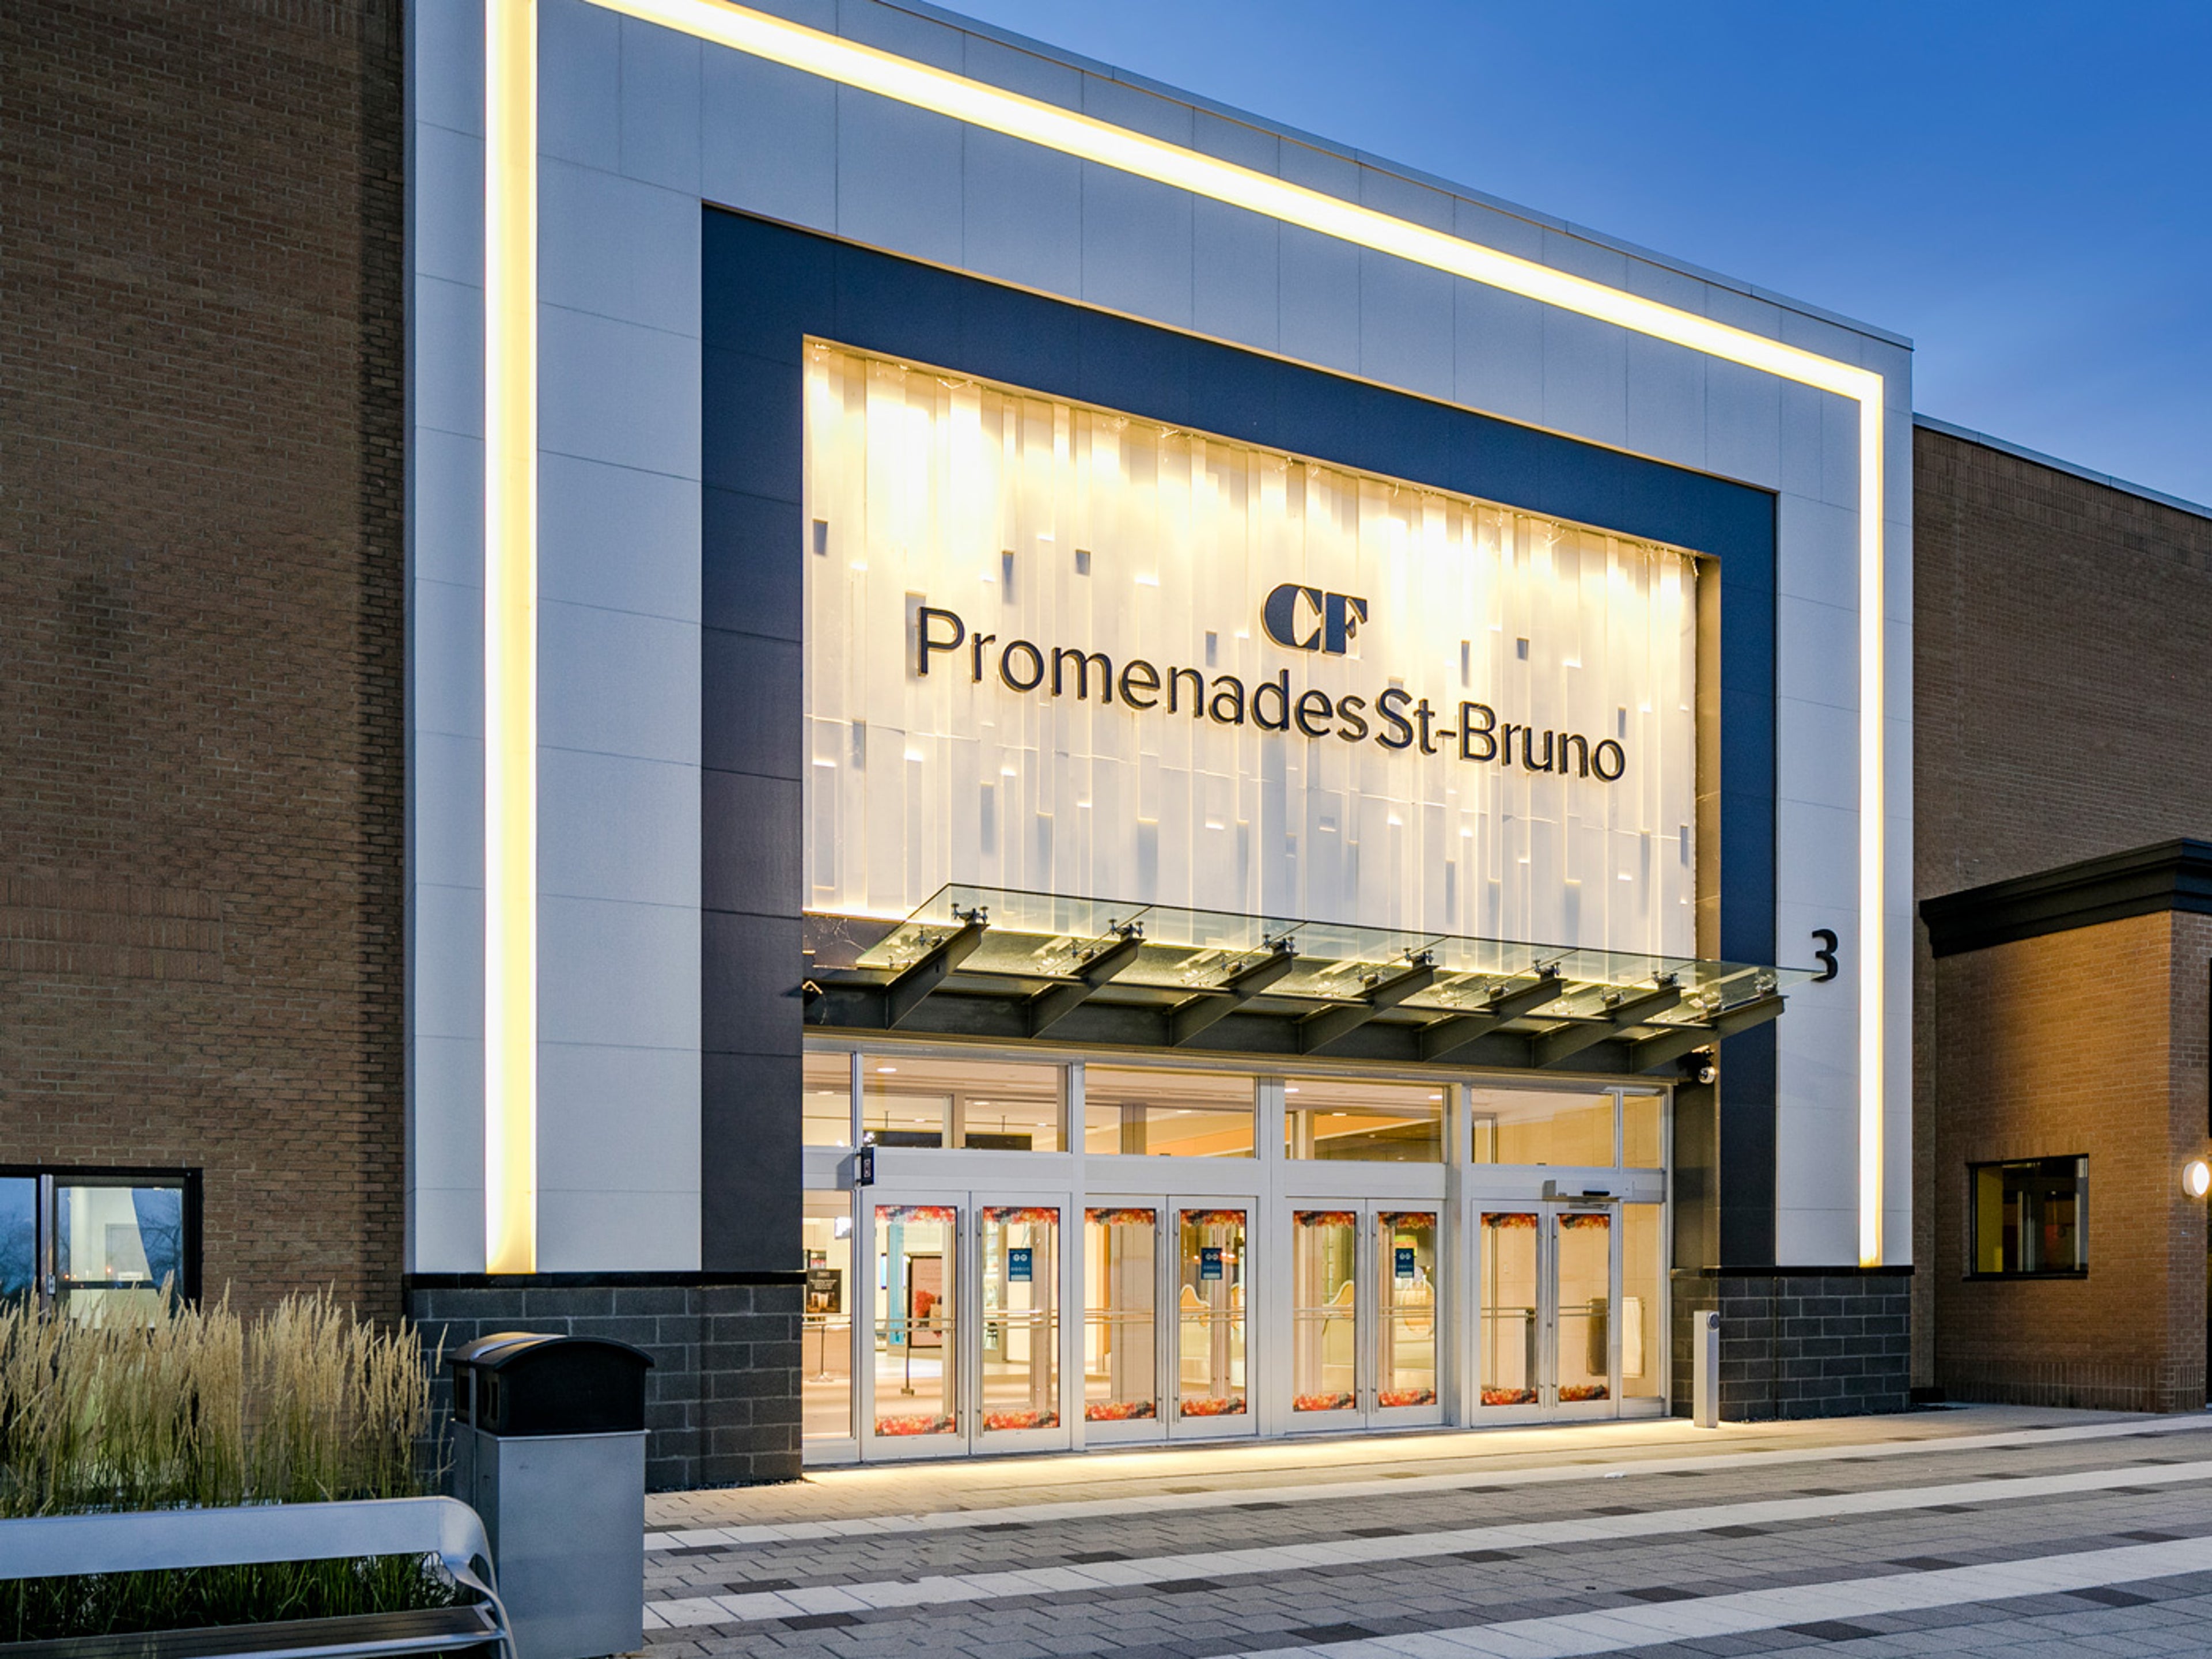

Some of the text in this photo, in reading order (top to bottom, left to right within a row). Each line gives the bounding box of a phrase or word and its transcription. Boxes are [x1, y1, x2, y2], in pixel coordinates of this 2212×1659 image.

[1262, 584, 1368, 655] CF
[918, 607, 1626, 782] Promenades St-Bruno
[1811, 929, 1838, 983] 3
